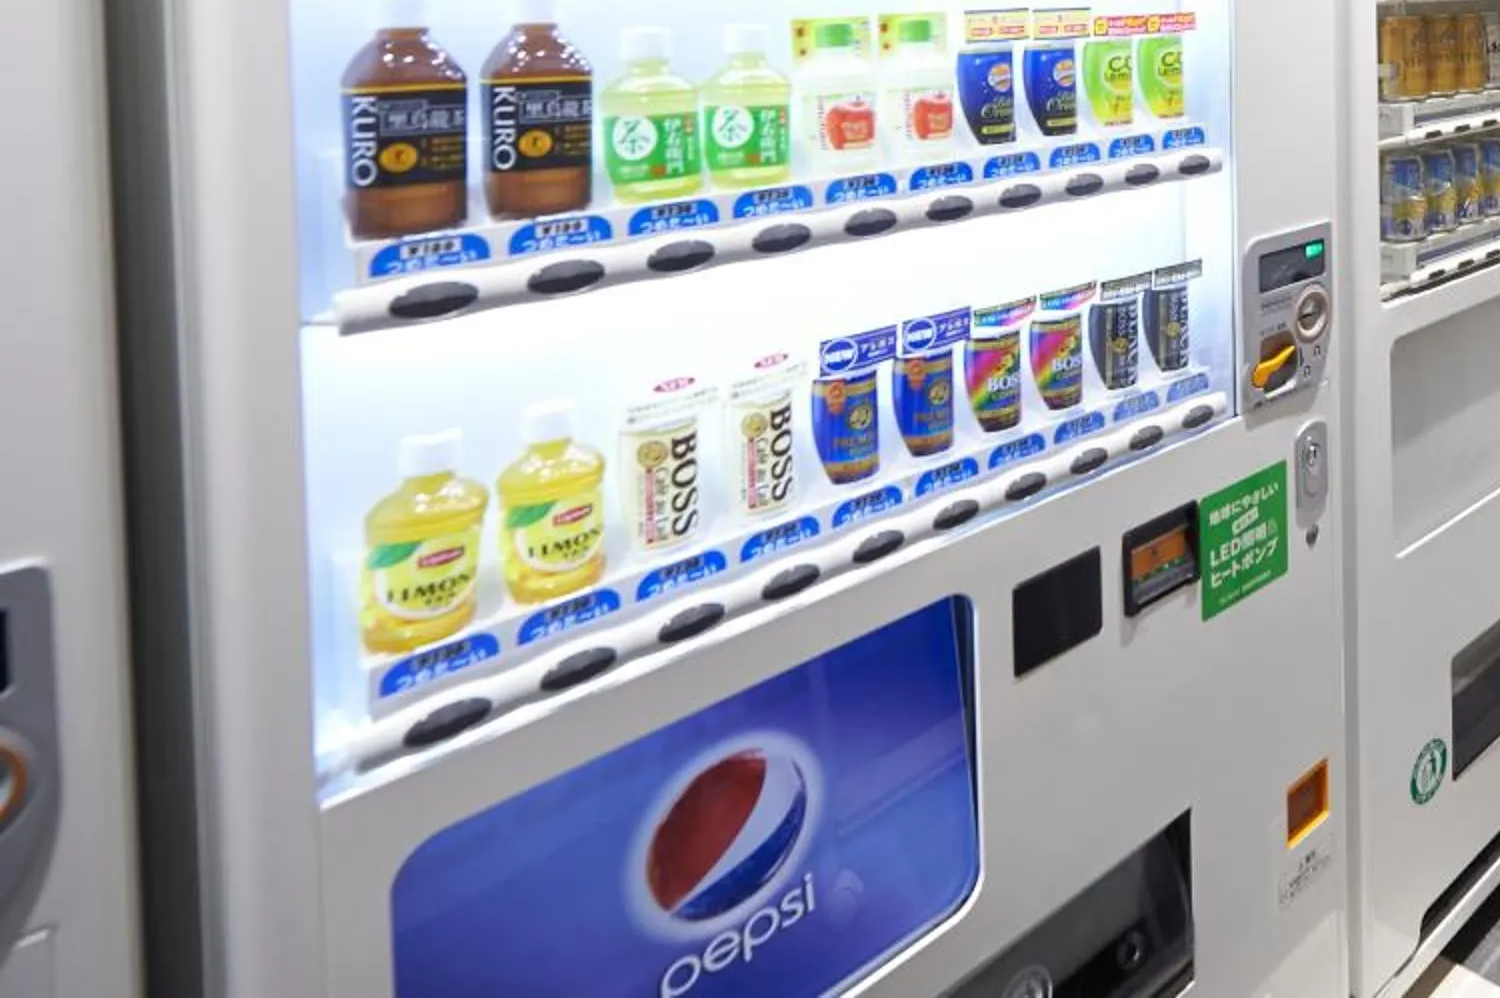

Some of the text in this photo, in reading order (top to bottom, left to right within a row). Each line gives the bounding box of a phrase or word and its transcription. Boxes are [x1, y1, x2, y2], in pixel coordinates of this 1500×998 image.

[351, 96, 378, 187] KURO
[493, 86, 517, 170] KURO
[618, 118, 650, 155] 茶
[719, 106, 749, 141] 茶
[987, 372, 1020, 391] BOS
[671, 433, 698, 536] BOSS
[771, 404, 792, 501] BOSS
[1211, 537, 1279, 588] ヒートポンプ
[660, 872, 815, 998] pepsi
